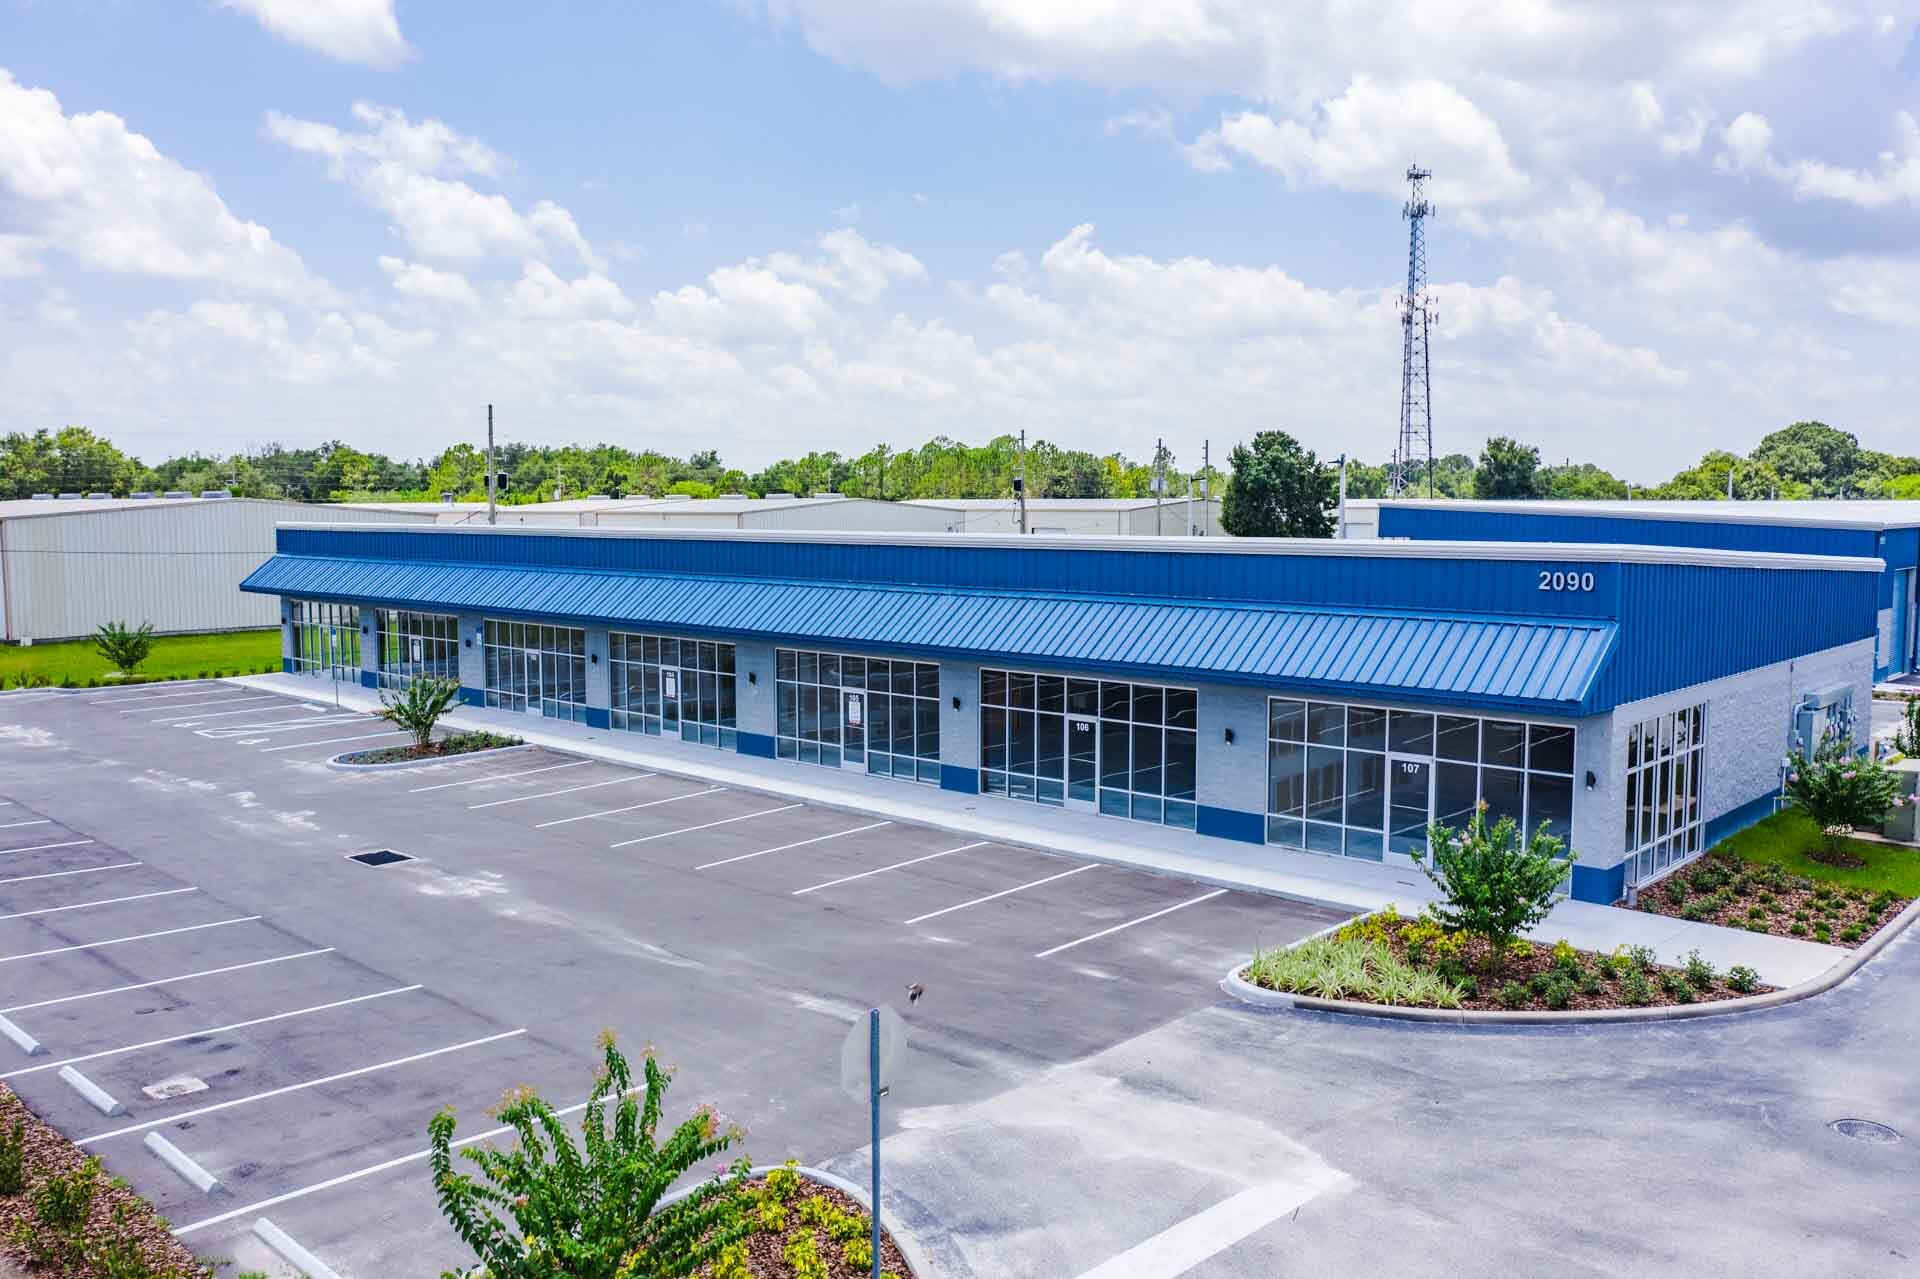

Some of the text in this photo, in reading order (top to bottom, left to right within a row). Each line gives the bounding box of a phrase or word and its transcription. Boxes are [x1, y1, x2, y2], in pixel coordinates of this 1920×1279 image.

[1538, 571, 1594, 591] 2090
[1076, 722, 1089, 731] 106
[1402, 763, 1420, 774] 107
